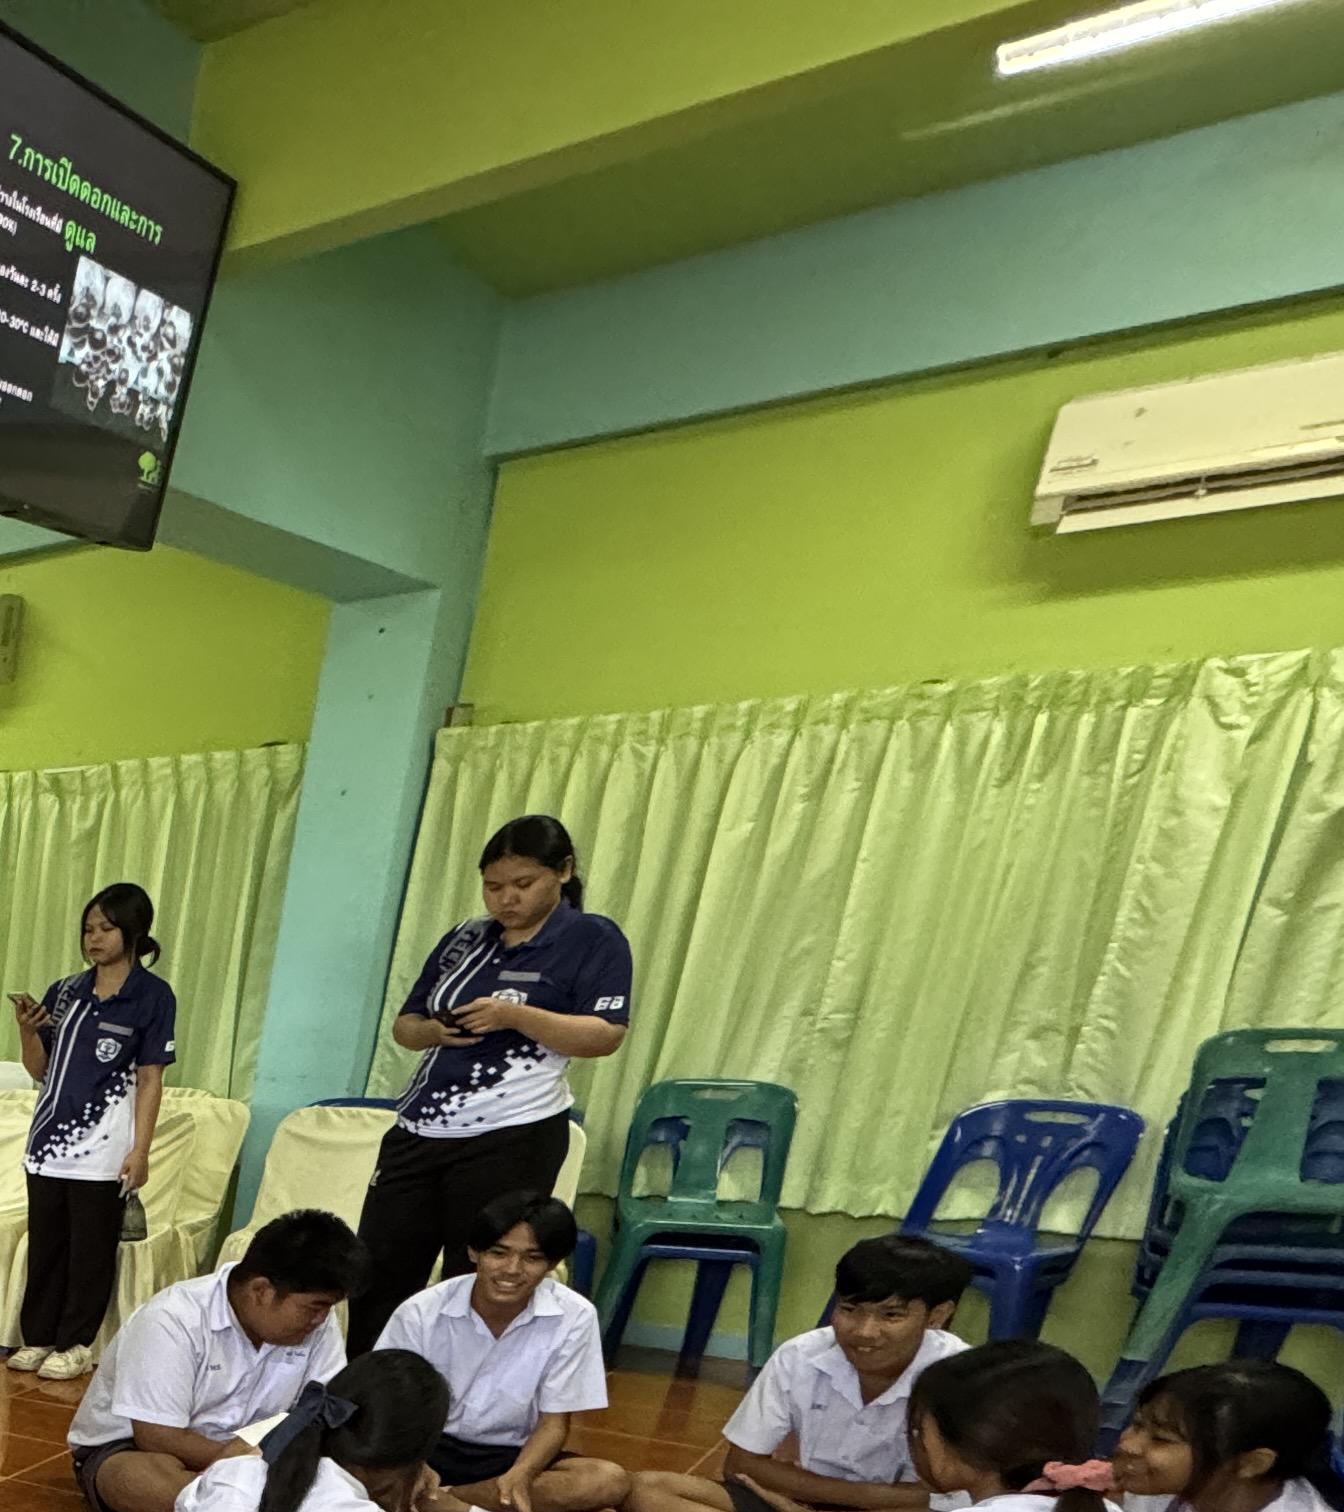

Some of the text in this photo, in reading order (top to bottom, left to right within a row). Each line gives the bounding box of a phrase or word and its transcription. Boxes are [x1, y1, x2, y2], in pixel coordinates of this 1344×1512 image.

[8, 133, 163, 246] 7.การเปิดดอกและการ
[64, 220, 97, 254] ดูแล
[30, 279, 47, 298] 2-3
[594, 995, 625, 1012] 68
